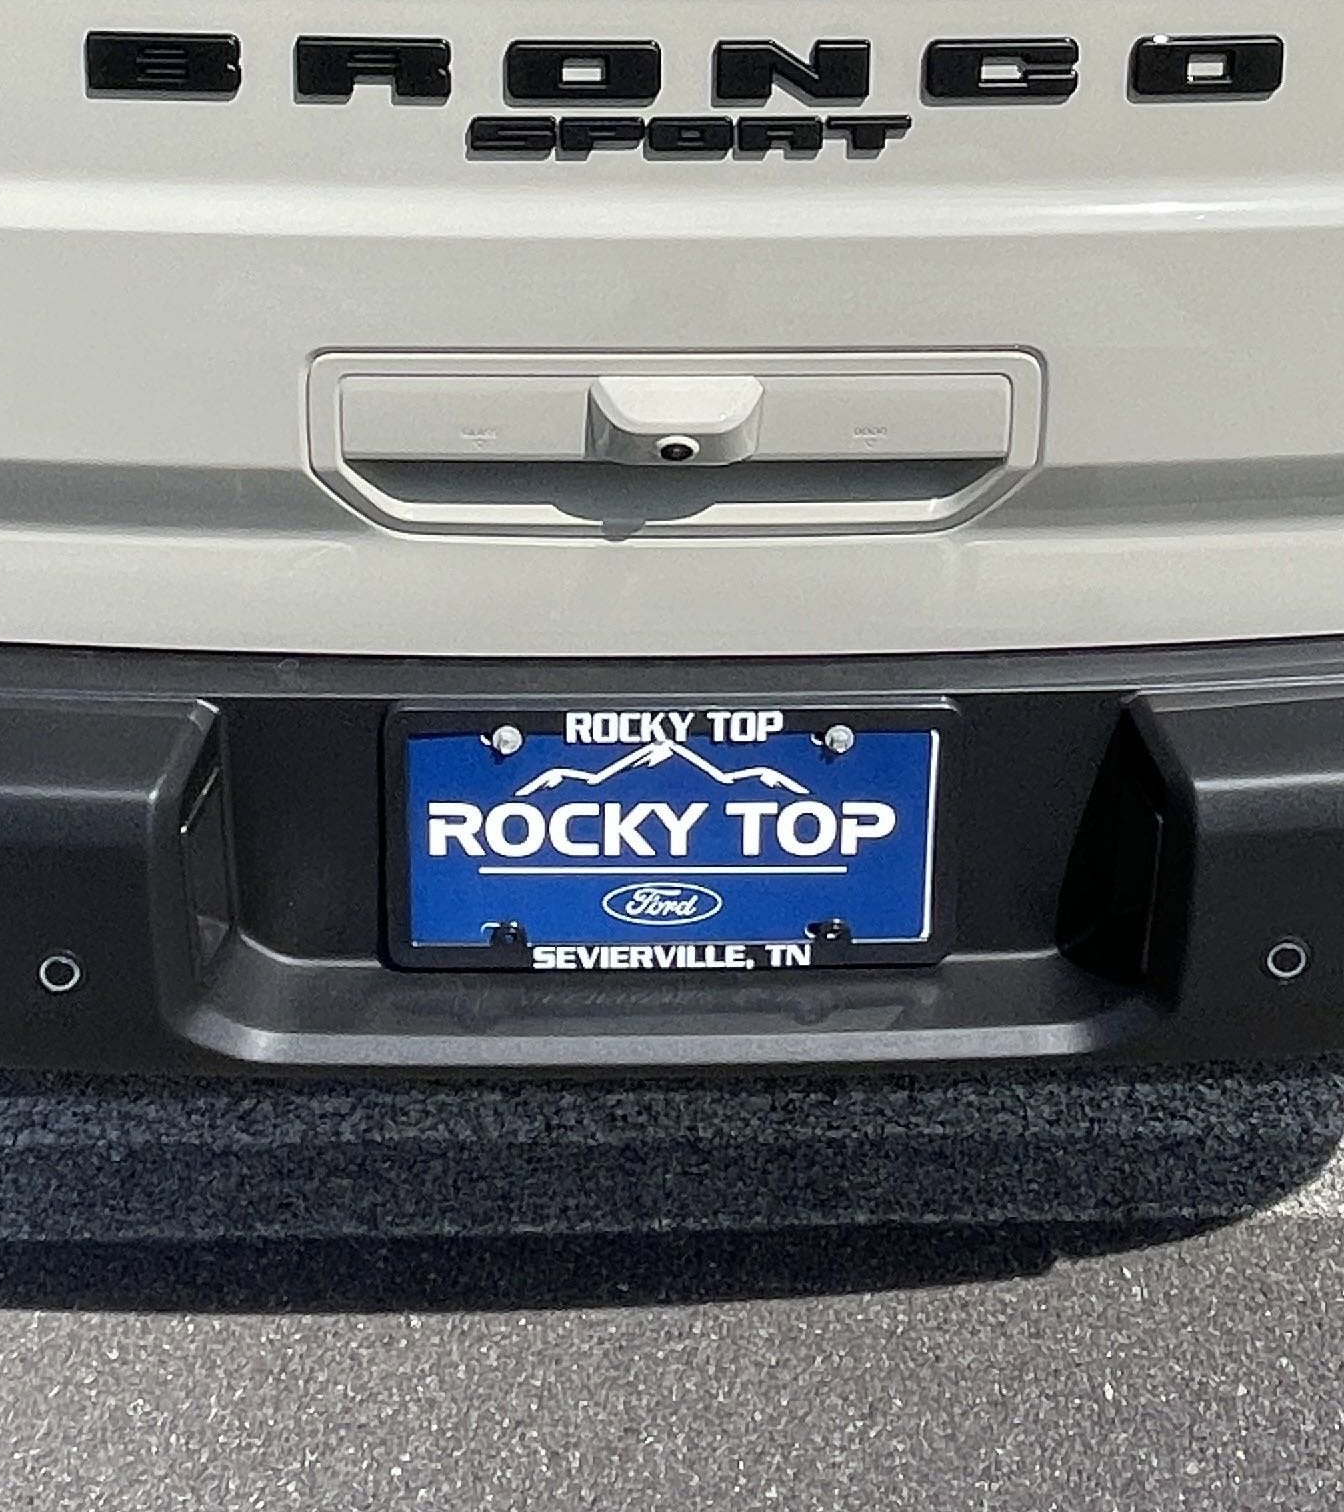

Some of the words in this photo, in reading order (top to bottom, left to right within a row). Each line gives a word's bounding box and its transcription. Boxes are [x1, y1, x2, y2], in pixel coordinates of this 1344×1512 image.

[85, 31, 1285, 106] BRONCO
[466, 113, 912, 163] SPORT
[566, 711, 695, 744] ROCKY
[706, 710, 784, 743] TOP
[427, 800, 709, 857] ROCKY
[724, 799, 897, 857] TOP
[624, 888, 700, 919] Ford
[532, 945, 755, 970] SEVIERVILLE,
[764, 944, 811, 967] TN
